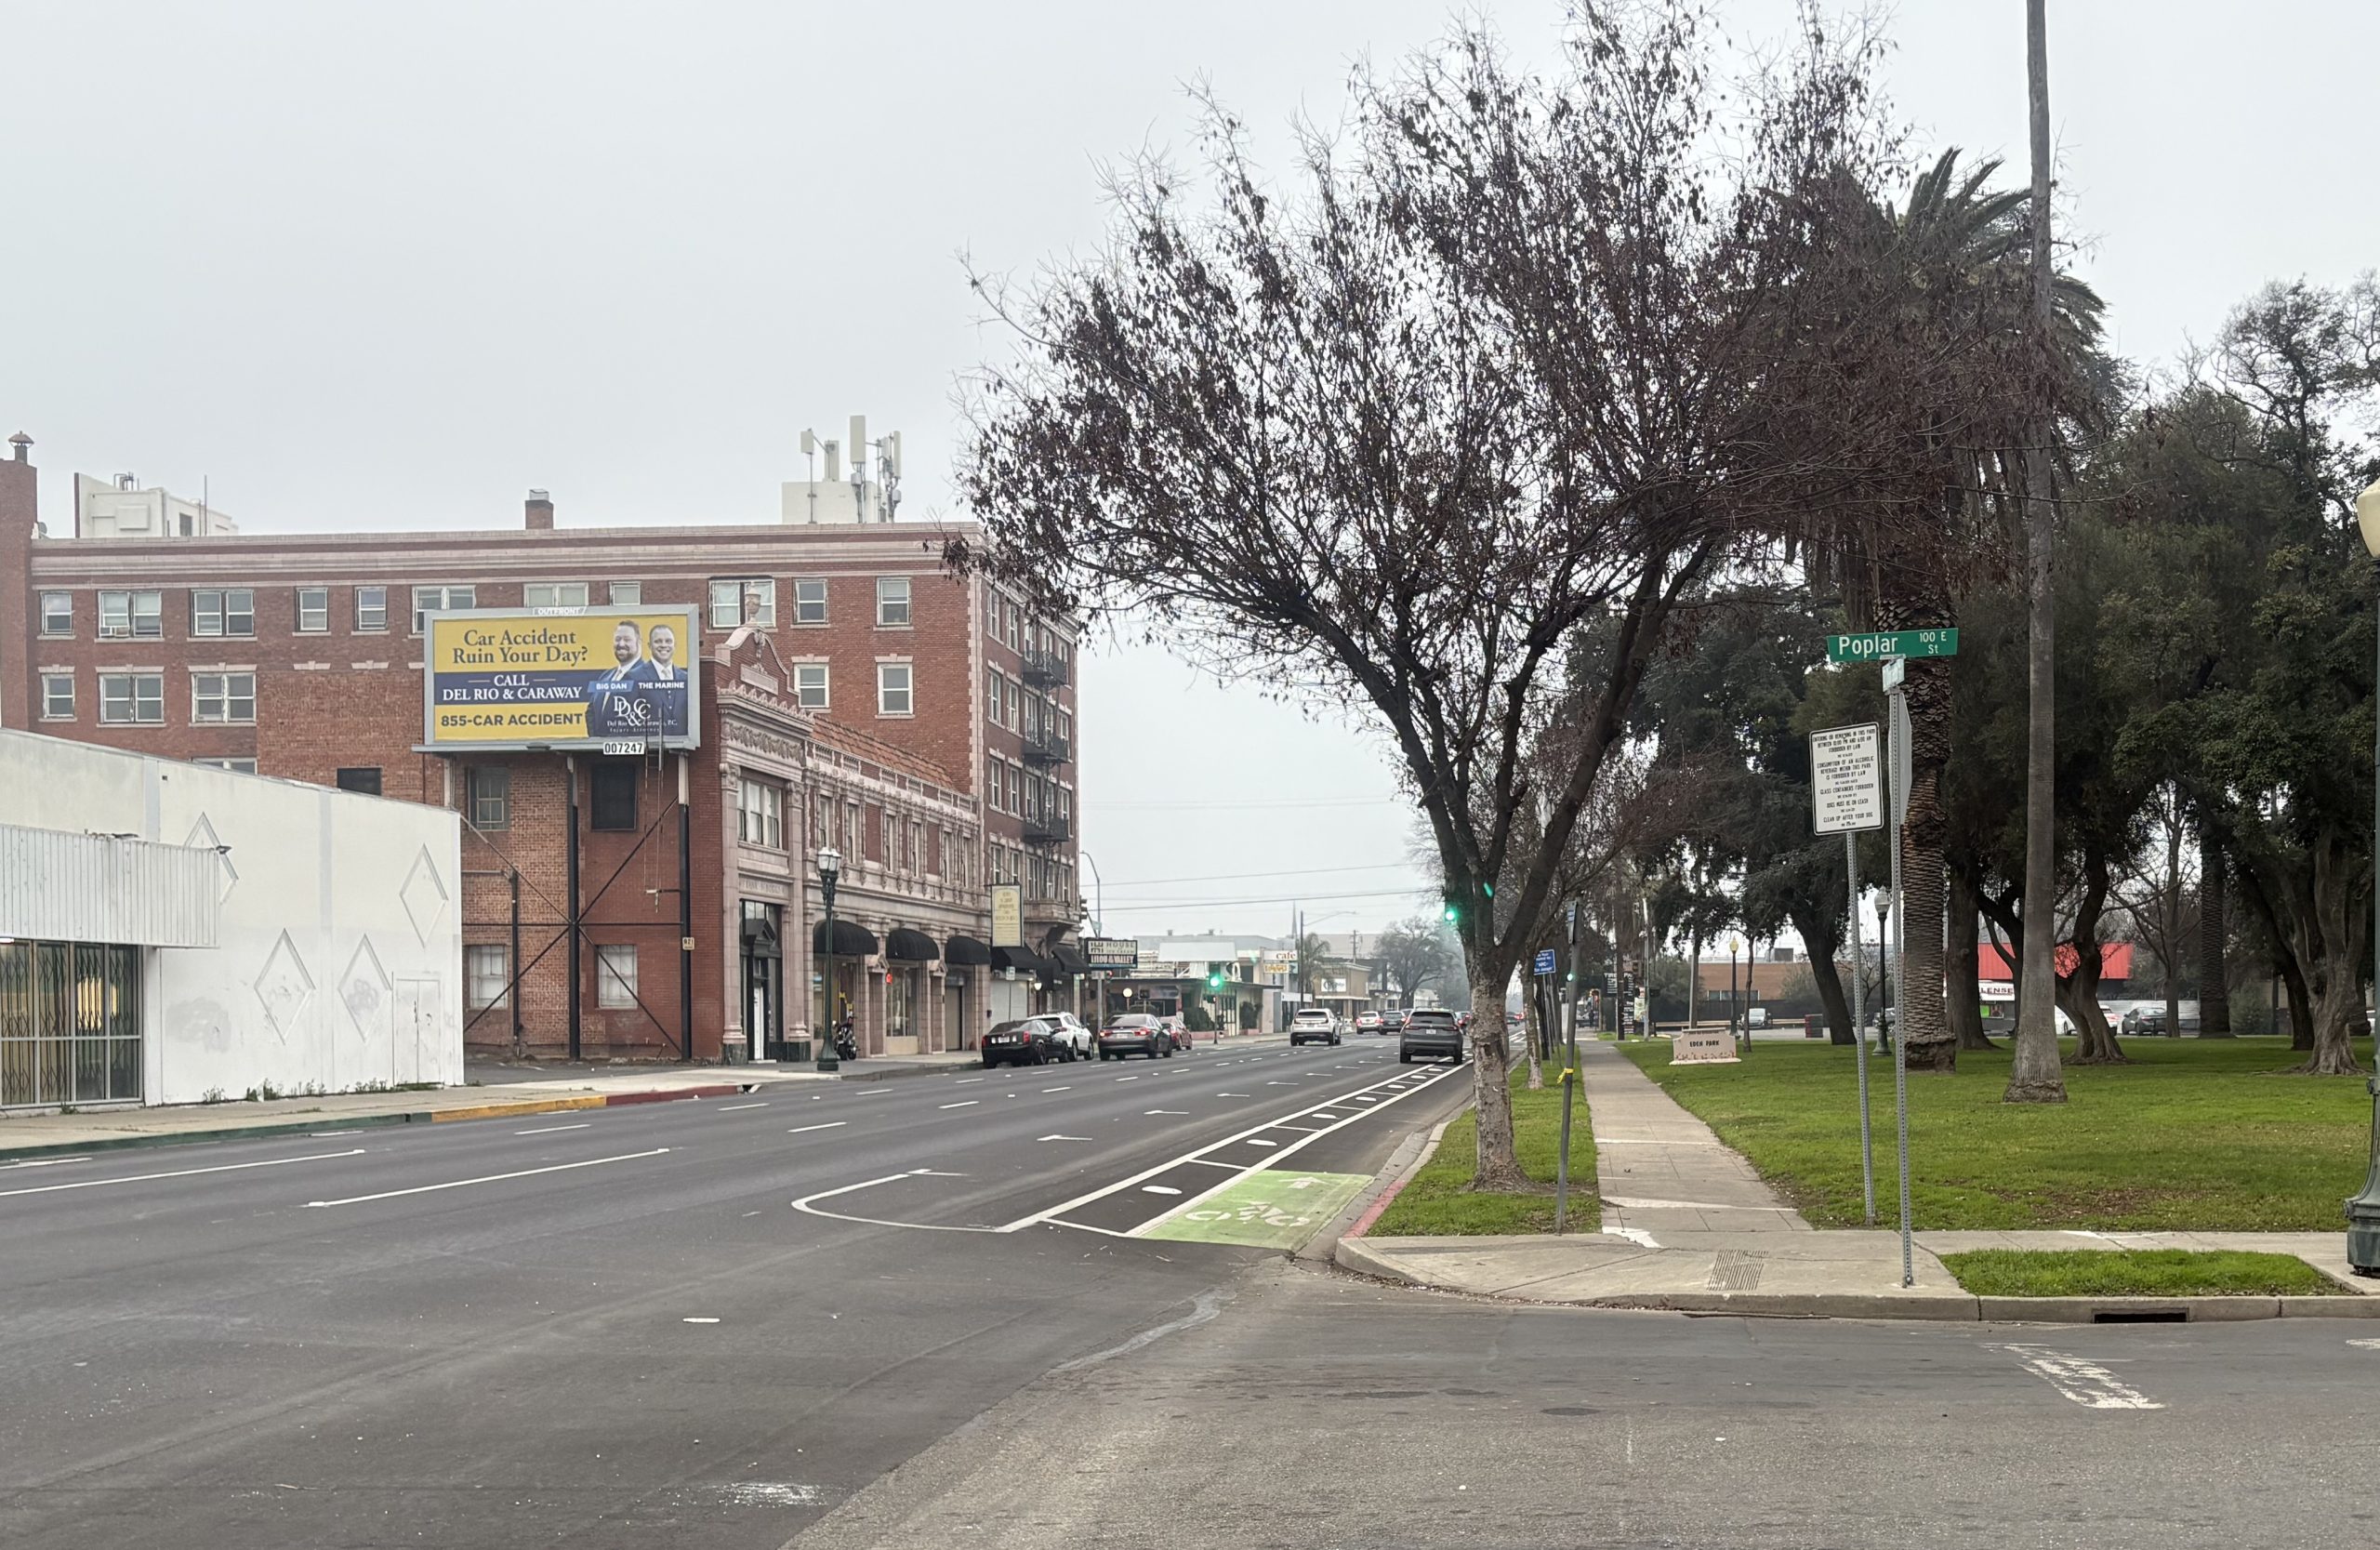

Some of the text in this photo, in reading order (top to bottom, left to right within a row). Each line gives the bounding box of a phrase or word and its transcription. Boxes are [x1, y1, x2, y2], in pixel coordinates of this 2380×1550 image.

[538, 607, 578, 616] OUTFRONT
[464, 628, 576, 646] Car Accident
[1920, 631, 1947, 643] 100 E
[1839, 635, 1938, 658] Poplar St
[453, 645, 588, 667] Ruin Your Day?
[494, 674, 530, 687] CALL
[443, 686, 583, 701] DEL RIO & CARAWAY
[441, 713, 583, 727] 855-CAR ACCIDENT
[604, 743, 643, 753] 007247
